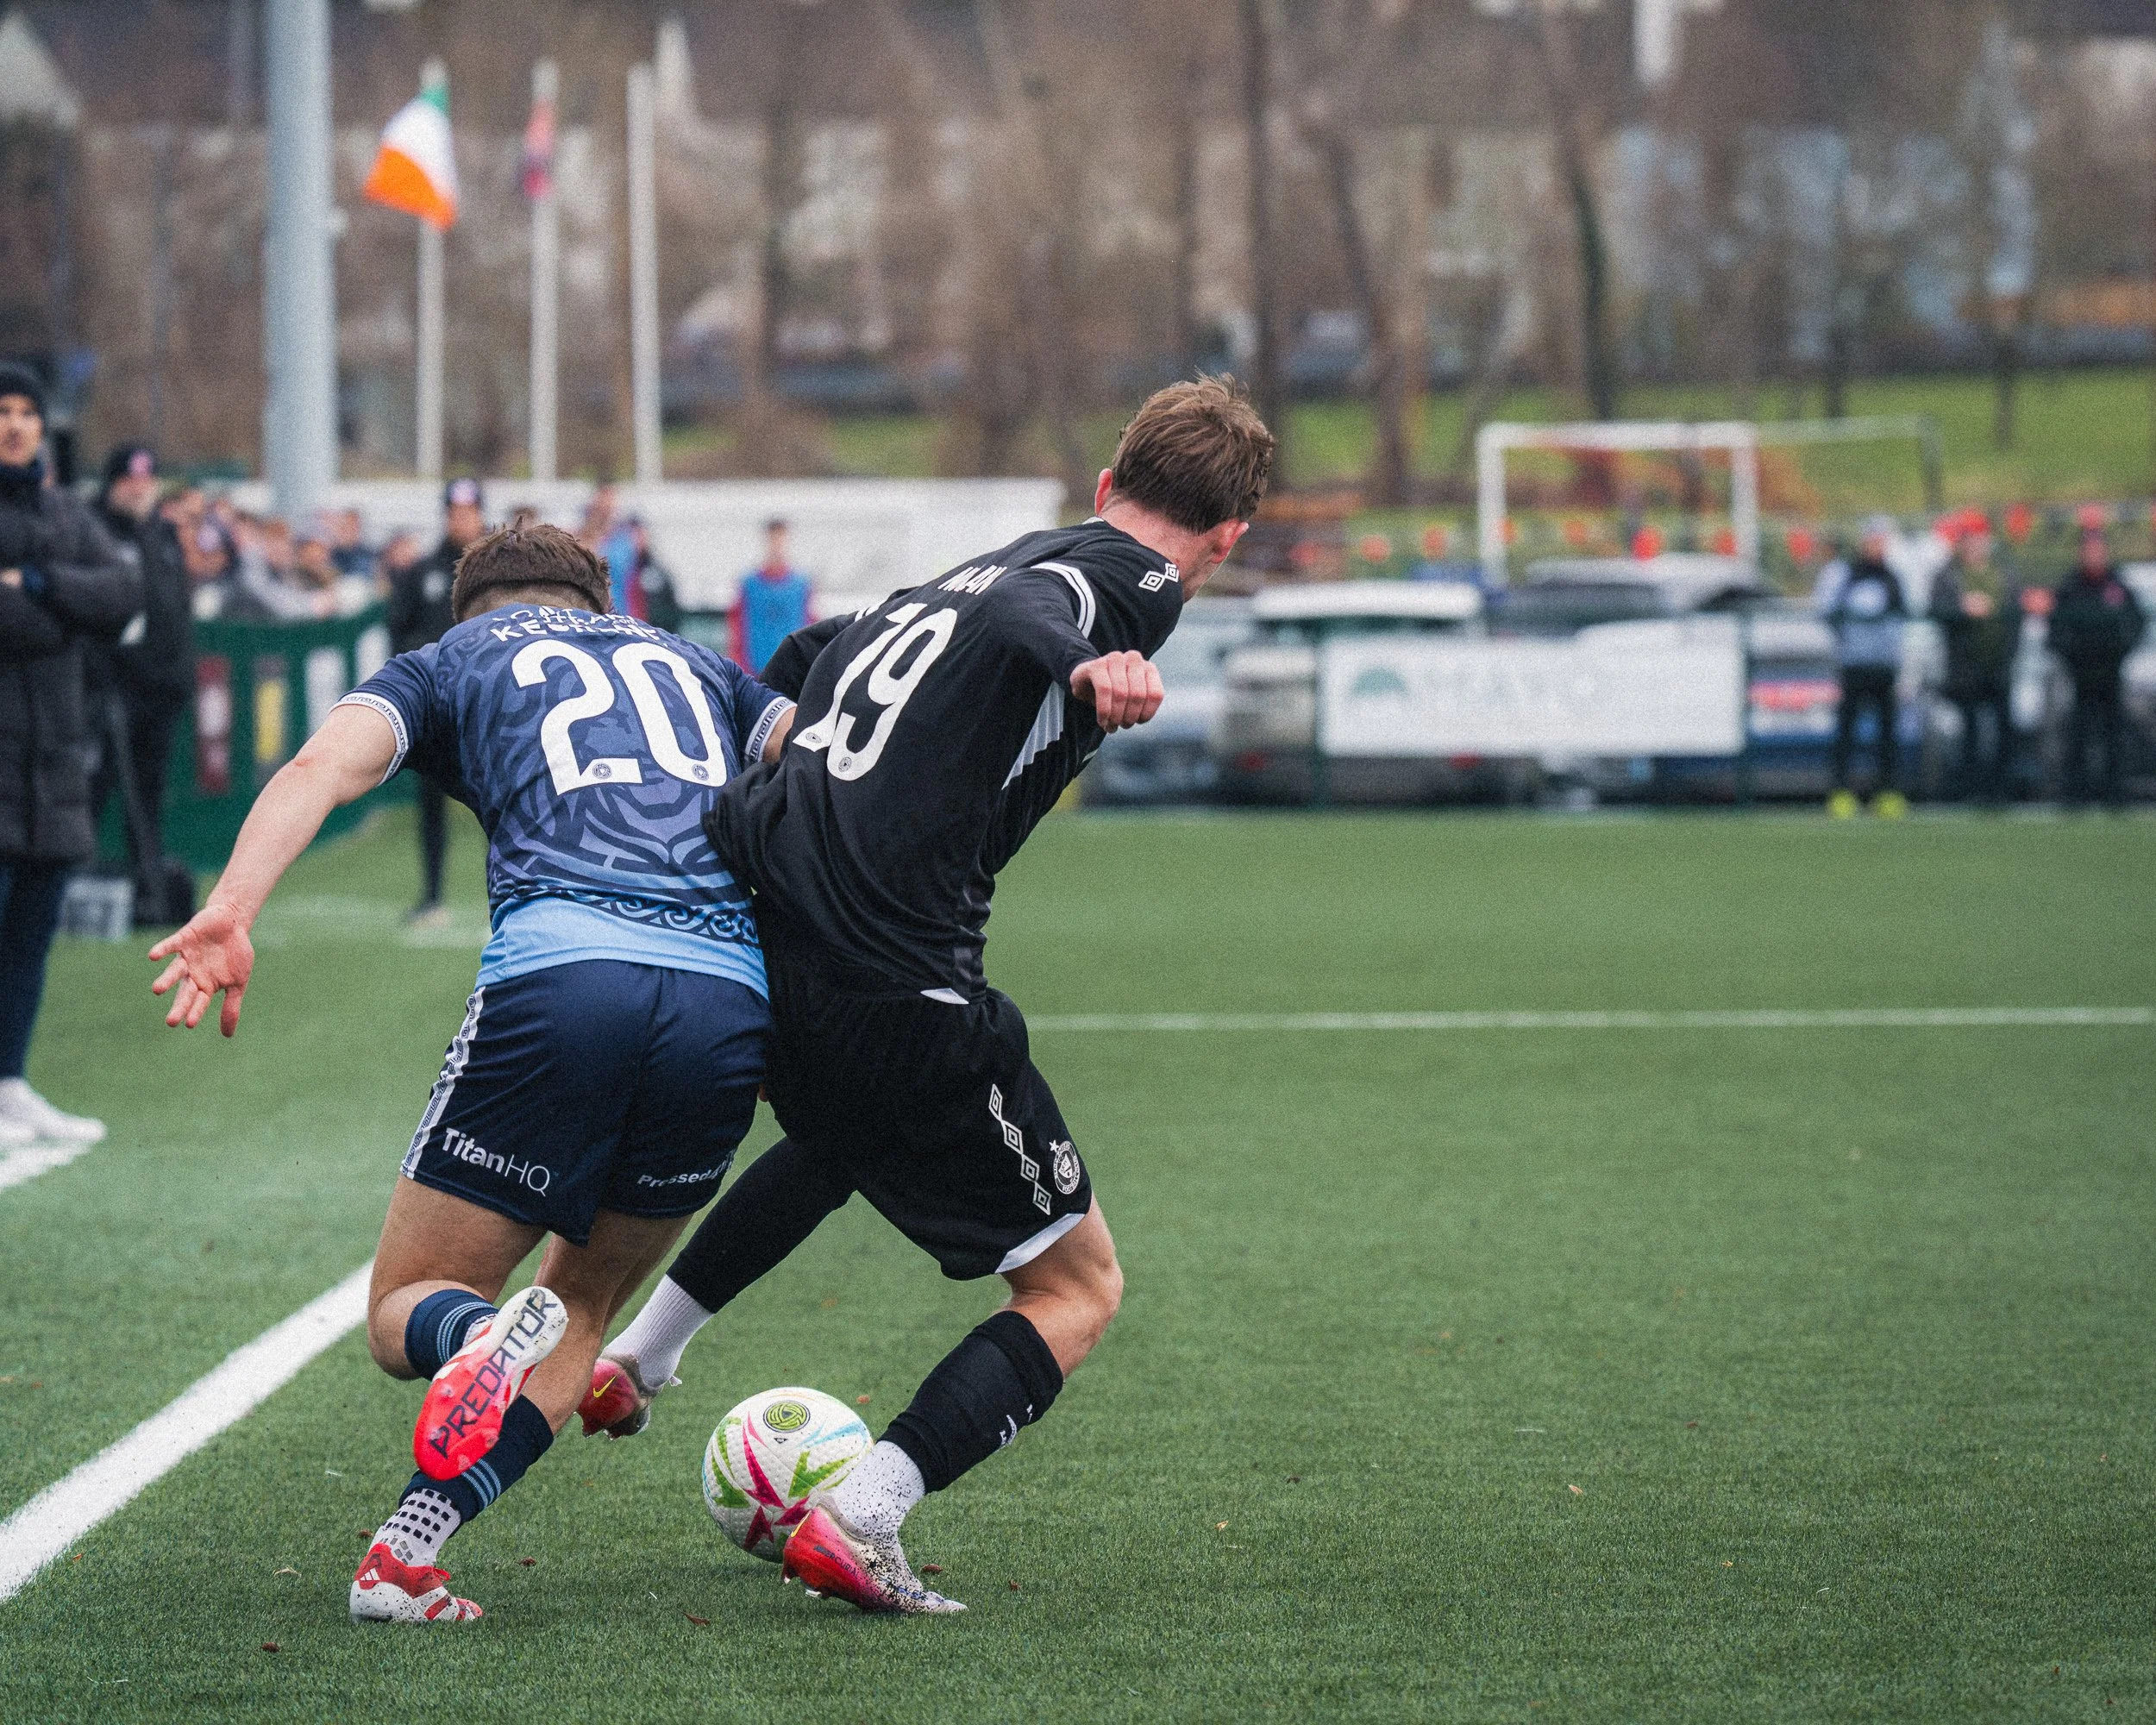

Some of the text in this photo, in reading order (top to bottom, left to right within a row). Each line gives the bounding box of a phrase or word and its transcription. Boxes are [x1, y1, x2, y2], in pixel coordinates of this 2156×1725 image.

[511, 639, 727, 795] 20
[793, 602, 958, 781] 19
[442, 1127, 550, 1196] TitanHQ
[429, 1289, 558, 1459] PREDATOR
